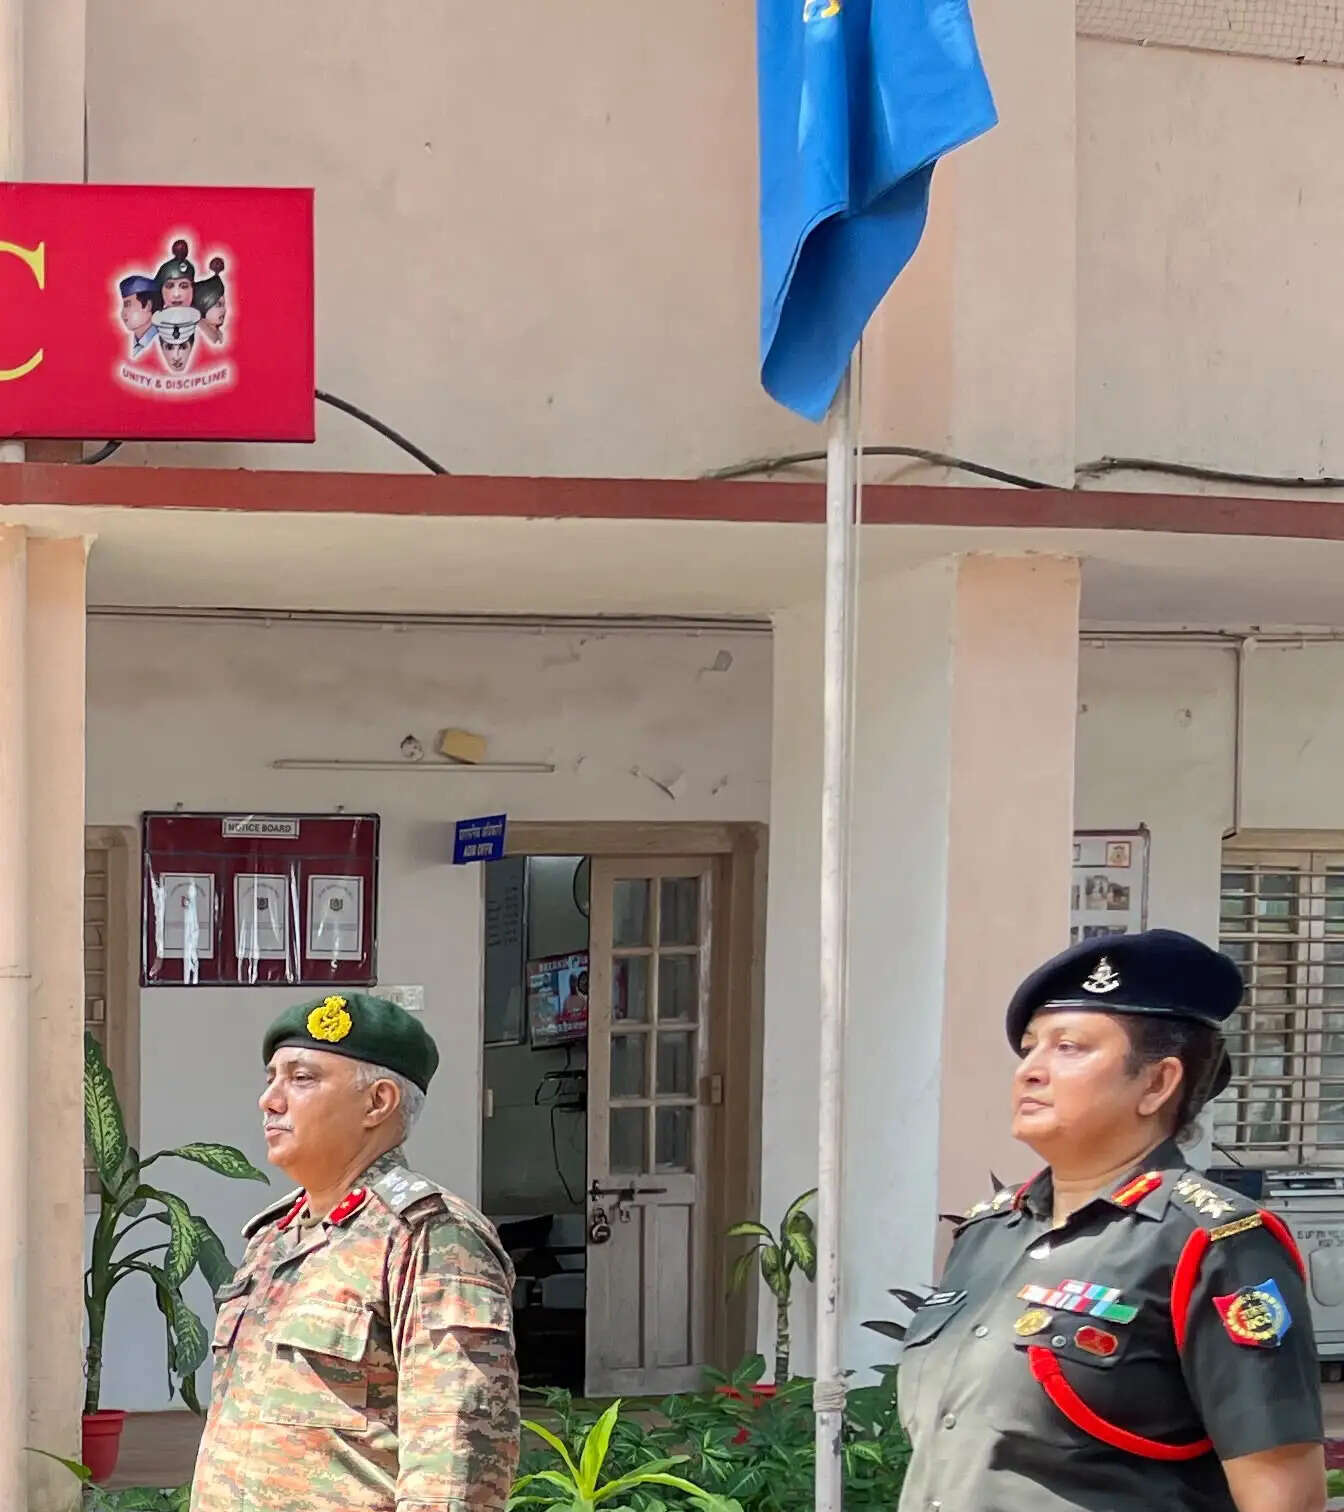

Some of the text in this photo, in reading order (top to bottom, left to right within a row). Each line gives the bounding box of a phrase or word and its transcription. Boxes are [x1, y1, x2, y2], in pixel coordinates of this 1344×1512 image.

[122, 368, 228, 390] UNITY & DISCIPLINE
